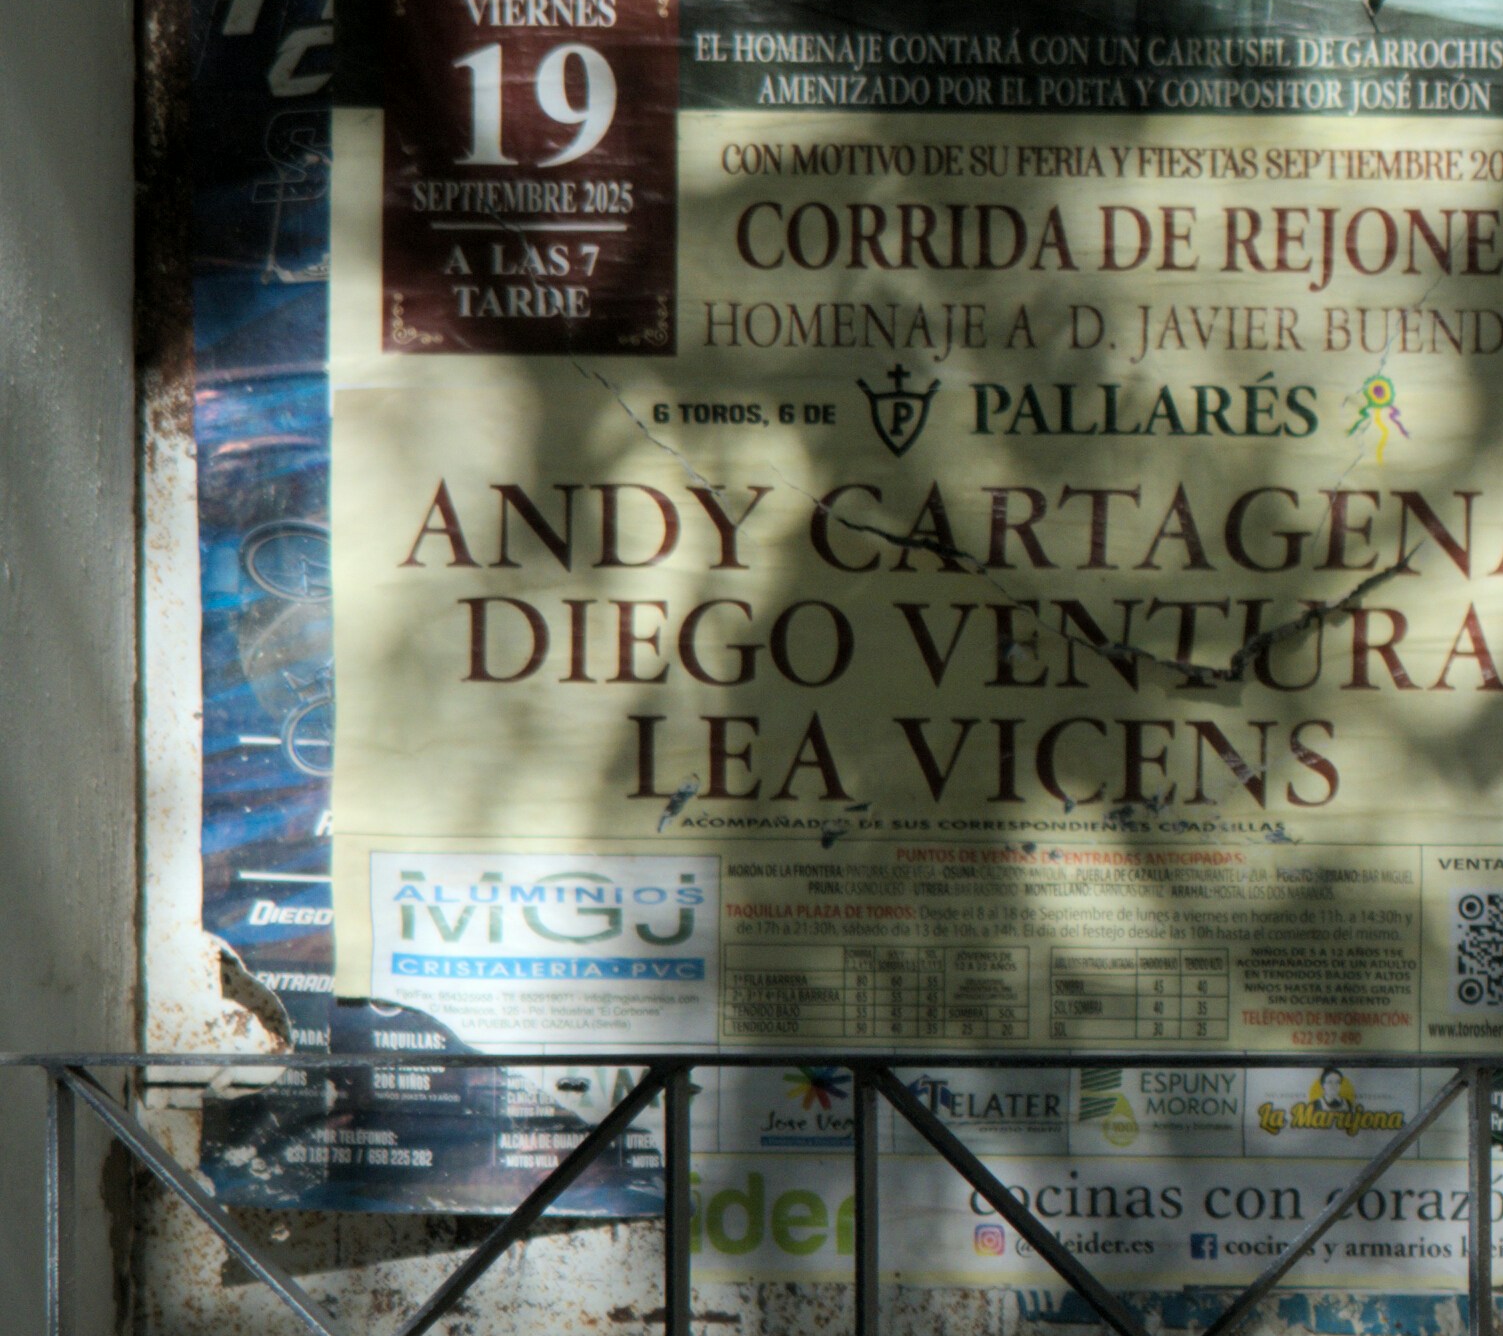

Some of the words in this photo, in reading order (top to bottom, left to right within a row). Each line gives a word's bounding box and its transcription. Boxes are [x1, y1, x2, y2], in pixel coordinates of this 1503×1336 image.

[695, 33, 727, 63] EL
[734, 33, 882, 72] HOMENAJE
[889, 28, 1021, 65] CONTARÁ
[1030, 36, 1088, 65] CON
[1101, 37, 1140, 65] UN
[1148, 39, 1290, 67] CARRUSEL
[1300, 40, 1335, 69] DE
[453, 41, 619, 170] 19
[758, 75, 931, 106] AMENIZADO
[938, 76, 992, 107] POR
[1003, 78, 1031, 106] EL
[1039, 77, 1126, 107] POETA
[1162, 79, 1343, 110] COMPOSITOR
[1350, 74, 1411, 115] JOSÉ
[1418, 74, 1492, 111] LEÓN
[721, 143, 782, 175] CON
[790, 144, 916, 177] MOTIVO
[923, 145, 963, 177] DE
[969, 145, 1008, 177] SU
[1016, 146, 1102, 179] FERIA
[1110, 146, 1131, 178] Y
[1137, 147, 1257, 180] FIESTAS
[1265, 148, 1464, 182] SEPTIEMBRE
[412, 181, 576, 215] SEPTIEMBRE
[582, 181, 635, 216] 2025
[735, 200, 1079, 273] CORRIDA
[1097, 204, 1200, 273] DE
[444, 247, 472, 277] A
[491, 245, 571, 278] LAS
[581, 244, 601, 277] 7
[453, 285, 590, 319] TARDE
[703, 301, 988, 362] HOMENAJE
[1005, 303, 1038, 350] A
[1070, 304, 1116, 351] D.
[1130, 304, 1307, 364] JAVIER
[653, 403, 670, 425] 6
[678, 403, 770, 428] TOROS,
[778, 403, 795, 426] 6
[803, 404, 836, 426] DE
[969, 371, 1319, 437] PALLARÉS
[397, 477, 775, 572] ANDY
[457, 596, 855, 689] DIEGO
[626, 710, 855, 802] LEA
[893, 717, 1340, 809] VICENS
[1438, 857, 1497, 872] VENTA
[392, 884, 705, 906] ALUMINIOS
[726, 904, 795, 920] TAQUILLA
[398, 956, 603, 978] CRISTALERÍA
[632, 960, 697, 978] PVC
[1140, 1071, 1237, 1097] ESPUNY
[1144, 1095, 1237, 1119] MORON
[970, 1172, 1183, 1220] cocinas
[1205, 1184, 1301, 1220] con
[1345, 1236, 1452, 1260] armarios
